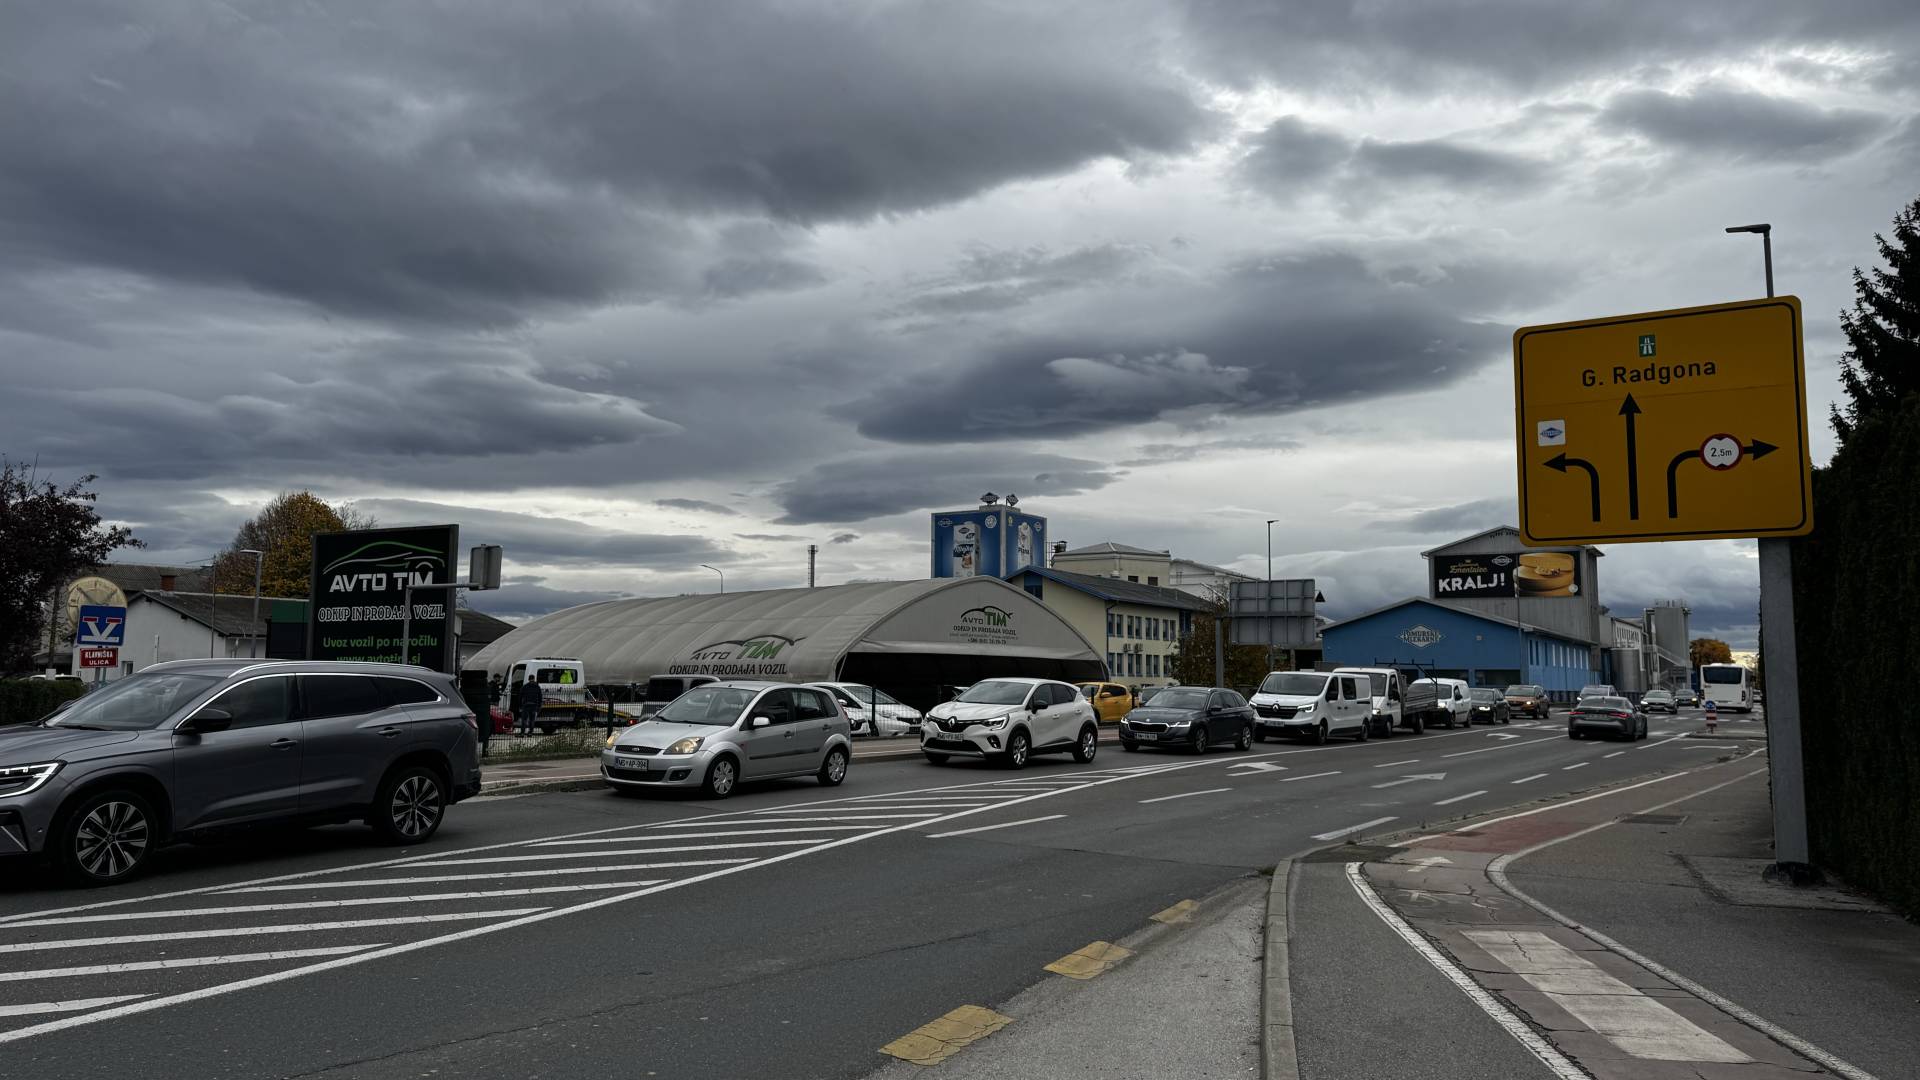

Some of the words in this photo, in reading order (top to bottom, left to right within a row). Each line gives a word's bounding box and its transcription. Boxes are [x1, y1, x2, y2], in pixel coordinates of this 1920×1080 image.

[1582, 369, 1604, 387] G.
[1613, 360, 1717, 385] Radgona
[329, 573, 387, 593] AVTO
[393, 571, 434, 591] TIM
[1438, 572, 1505, 592] KRALJ!
[318, 608, 351, 622] ODKUP
[351, 606, 364, 621] IN
[413, 603, 446, 619] VOZIL
[962, 616, 983, 625] AVTO
[984, 612, 1007, 627] TIM
[323, 637, 348, 648] Uvoz
[350, 636, 374, 647] vozil
[376, 638, 390, 649] po
[690, 651, 732, 660] AVTO
[736, 640, 787, 660] TIM
[669, 665, 699, 675] ODKUP
[700, 665, 711, 675] IN
[711, 664, 756, 675] PRODAJA
[758, 663, 788, 675] VOZIL
